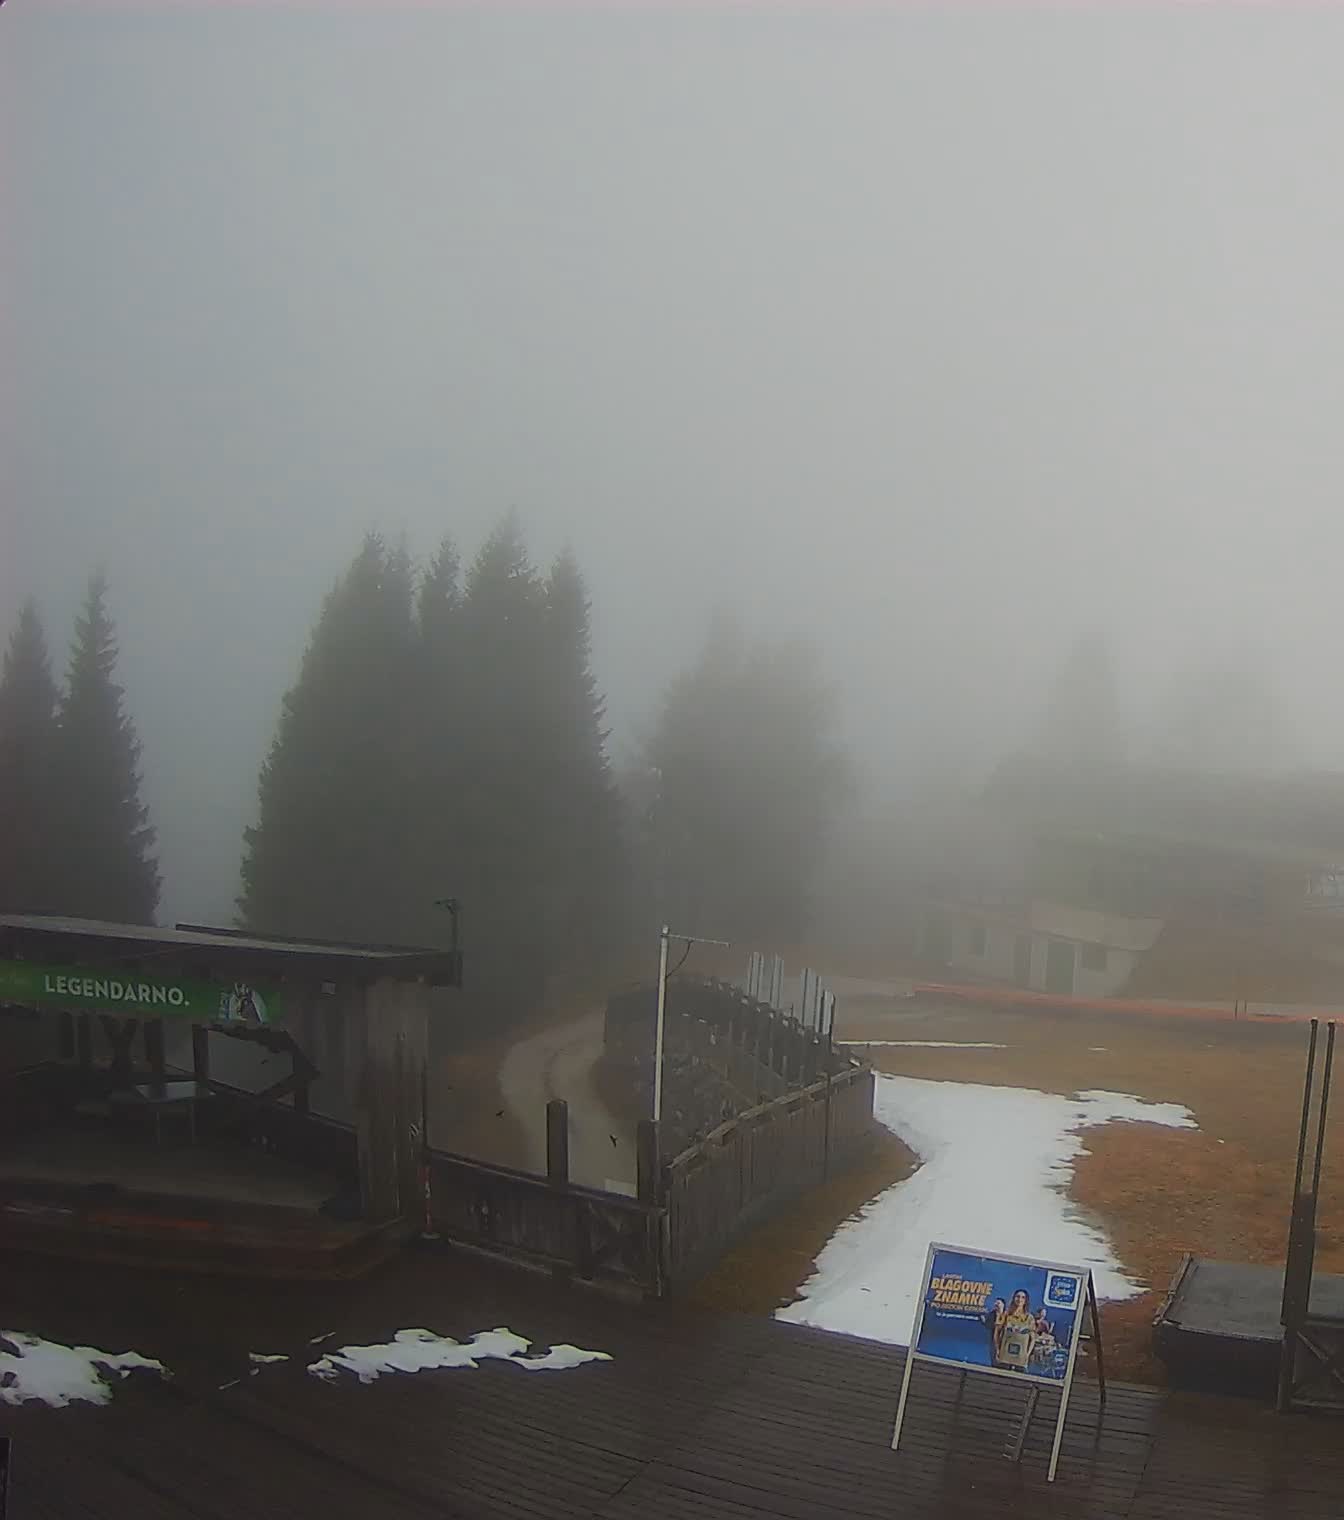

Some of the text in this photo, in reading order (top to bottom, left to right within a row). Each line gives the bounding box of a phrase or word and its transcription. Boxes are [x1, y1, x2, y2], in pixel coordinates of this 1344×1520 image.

[44, 974, 190, 1006] LEGENDARNO.
[930, 1277, 993, 1296] BLAGOVNE
[933, 1290, 987, 1307] ZNAMKE
